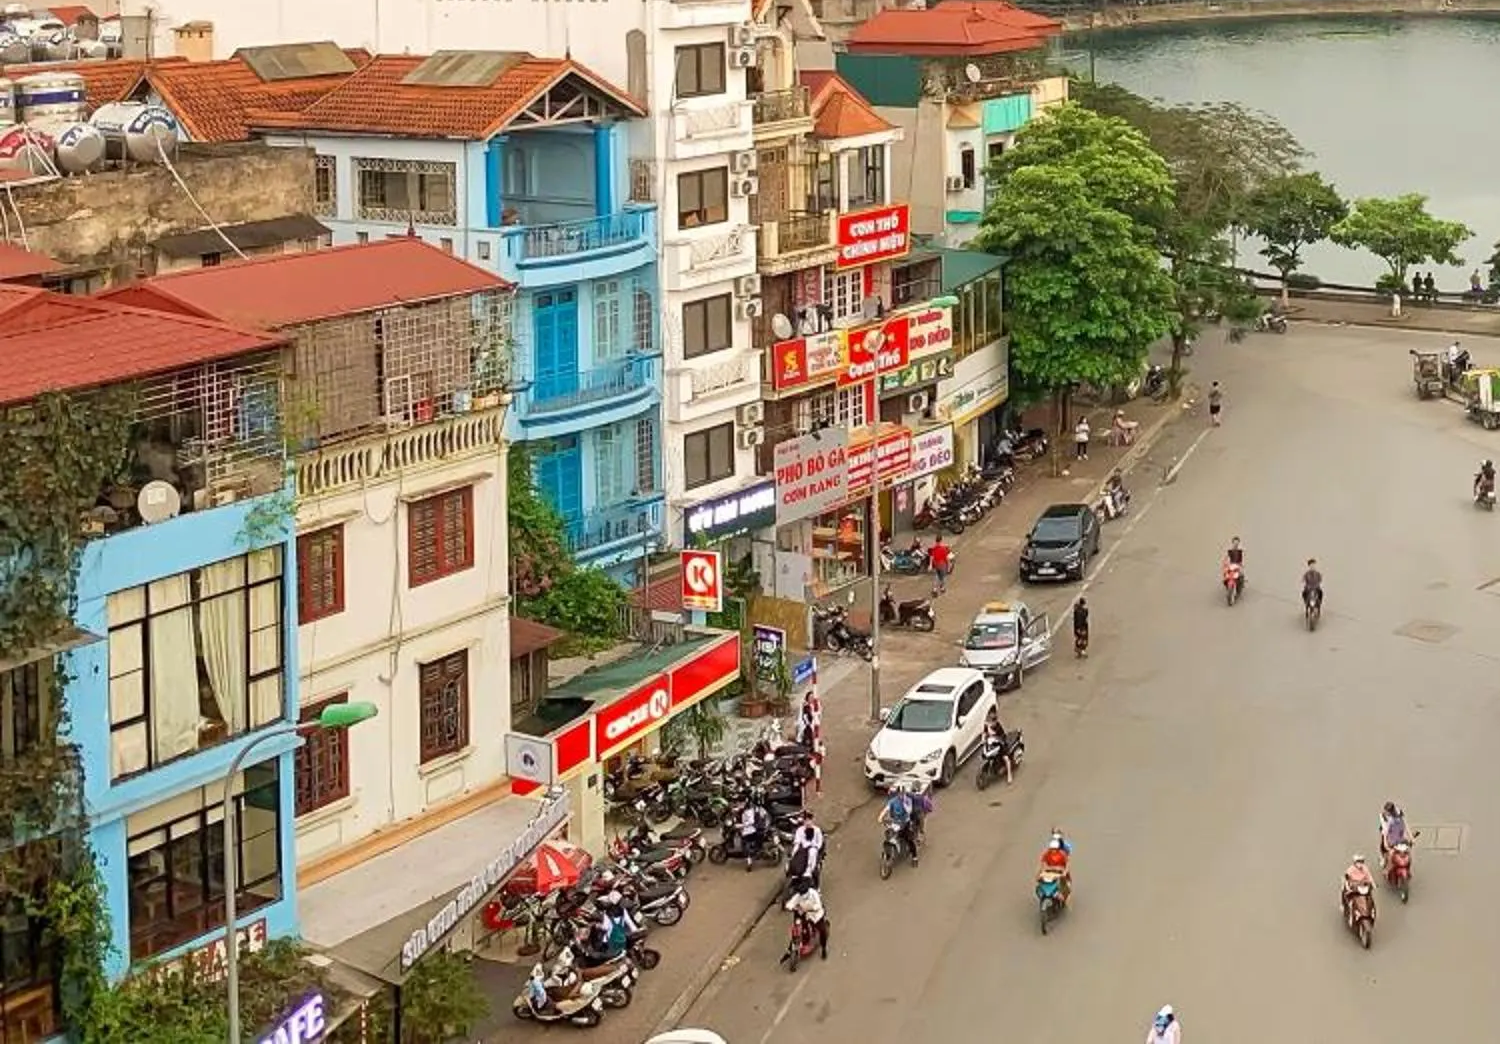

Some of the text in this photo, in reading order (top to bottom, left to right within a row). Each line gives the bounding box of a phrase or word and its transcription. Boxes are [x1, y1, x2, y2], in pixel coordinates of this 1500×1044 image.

[829, 443, 847, 469] GÀ
[809, 475, 841, 497] RANG
[260, 994, 325, 1044] AFE
